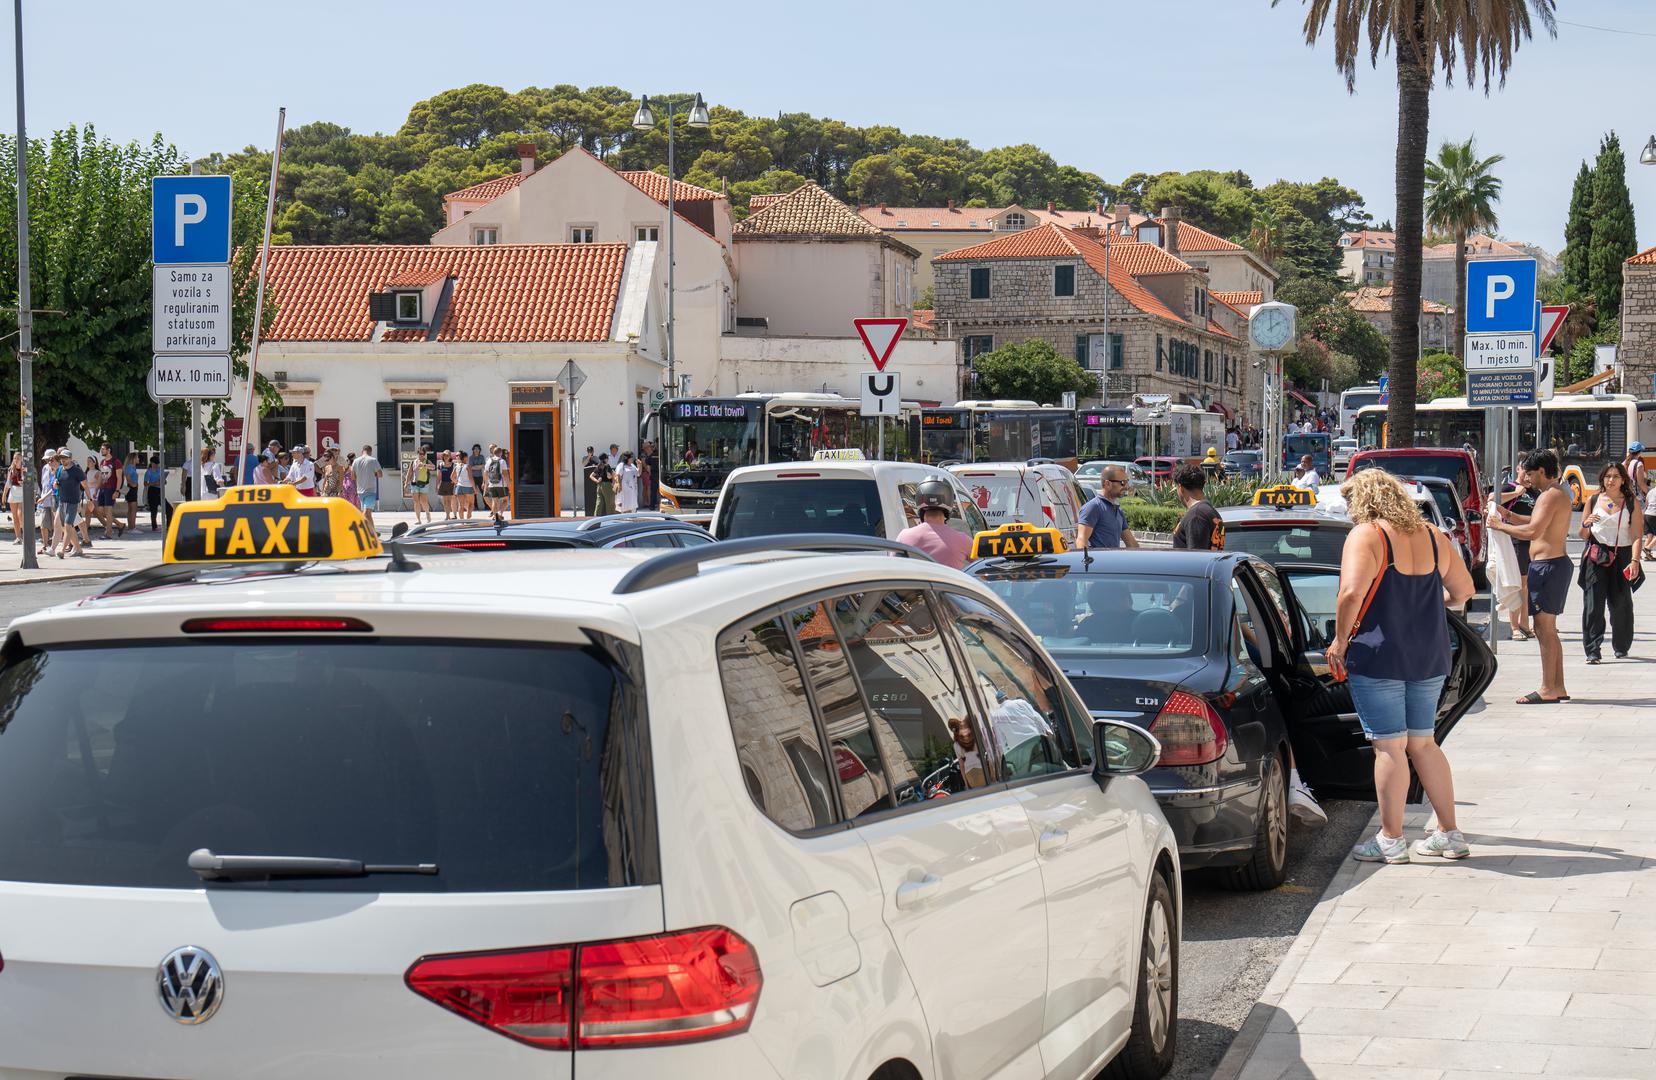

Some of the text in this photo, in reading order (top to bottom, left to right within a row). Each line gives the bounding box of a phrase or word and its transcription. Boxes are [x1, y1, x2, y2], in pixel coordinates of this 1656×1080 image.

[175, 194, 207, 247] P
[171, 270, 213, 283] Samo za
[172, 286, 211, 298] vozila s
[1486, 275, 1515, 318] P
[164, 302, 219, 316] reguliranim
[168, 318, 215, 330] statusom
[166, 333, 216, 348] parkiranja
[1471, 338, 1528, 351] Max. 10 min.
[1479, 353, 1519, 367] 1 mjesto
[157, 369, 226, 382] MAX. 10 min.
[680, 404, 692, 417] 1B
[819, 451, 840, 460] TAXI
[235, 489, 272, 502] 119
[1266, 493, 1304, 504] TAXI
[197, 515, 310, 556] TAXI
[988, 535, 1043, 555] TAXI
[1135, 697, 1159, 706] CDI
